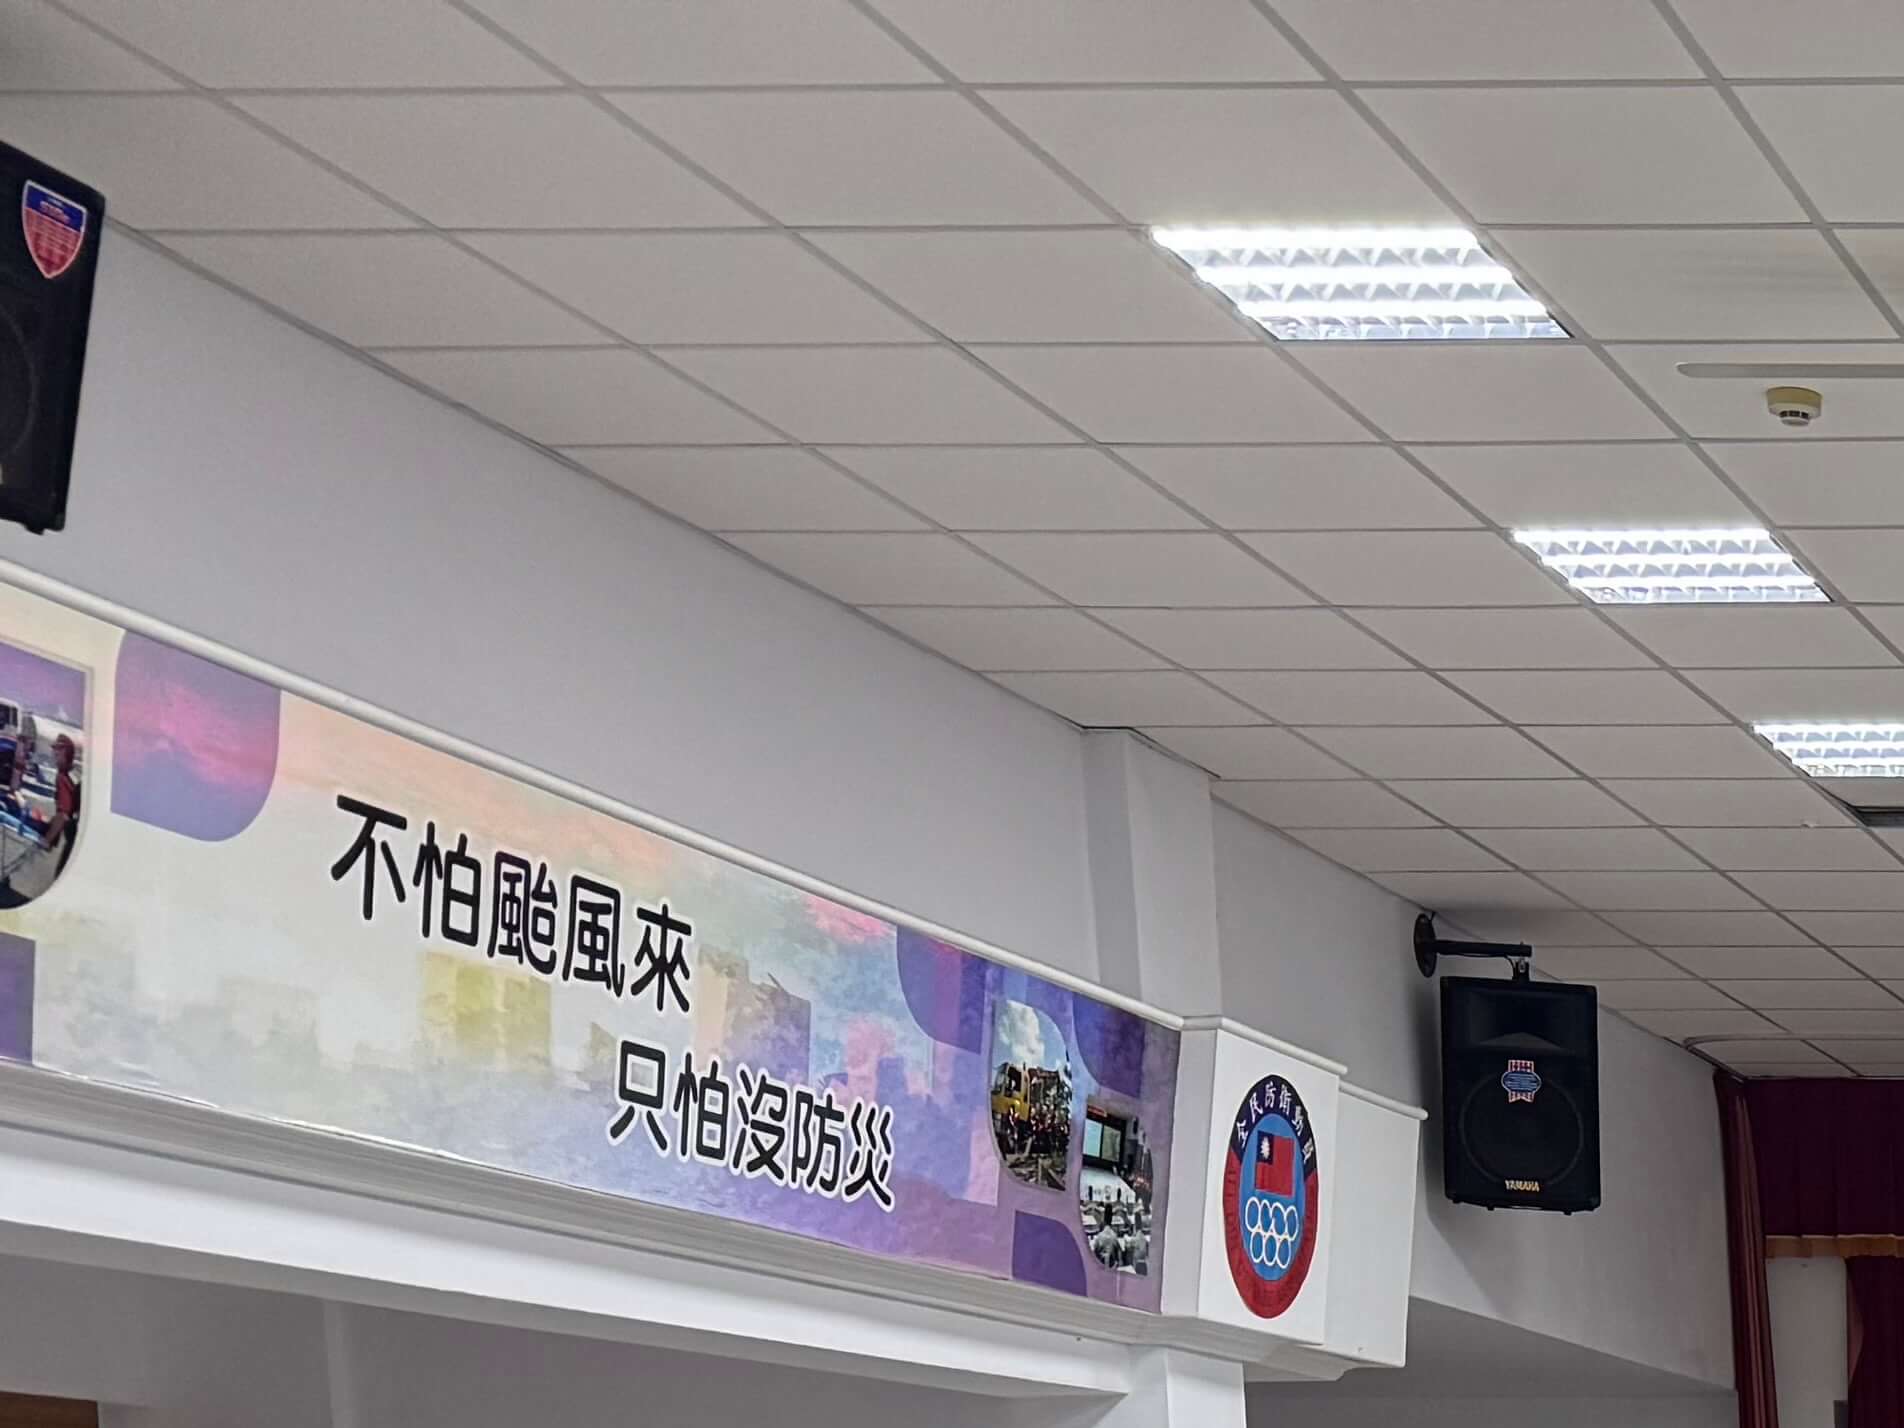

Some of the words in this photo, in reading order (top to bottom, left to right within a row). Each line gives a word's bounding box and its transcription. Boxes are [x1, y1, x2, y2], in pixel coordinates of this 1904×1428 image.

[330, 793, 692, 1012] 不怕颱風來
[609, 1039, 893, 1207] 只怕沒防災
[1504, 1179, 1540, 1192] YAMAHA
